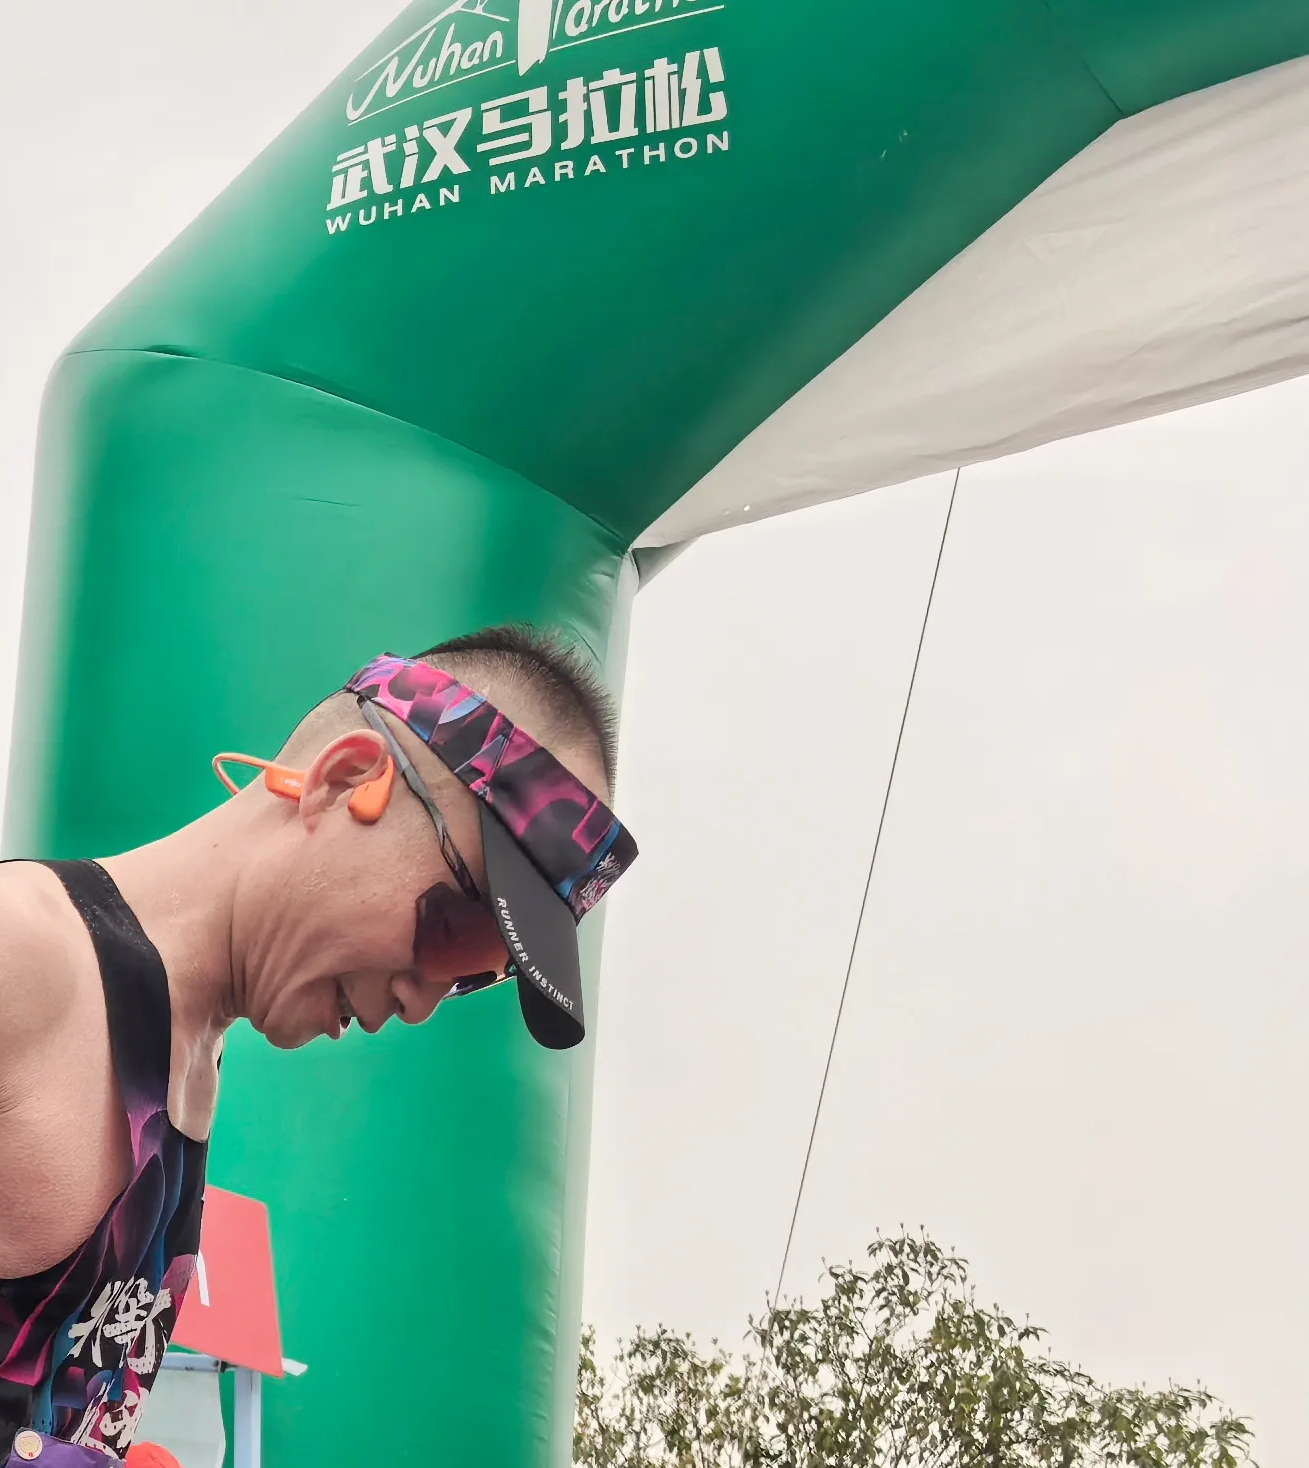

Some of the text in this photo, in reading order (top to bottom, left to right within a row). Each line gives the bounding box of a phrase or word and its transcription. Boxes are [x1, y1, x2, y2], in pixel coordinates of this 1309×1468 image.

[326, 131, 730, 235] WUHAN MARATHON
[327, 46, 728, 210] 武汉马拉松
[497, 897, 573, 1010] RUNNER INSTINCT
